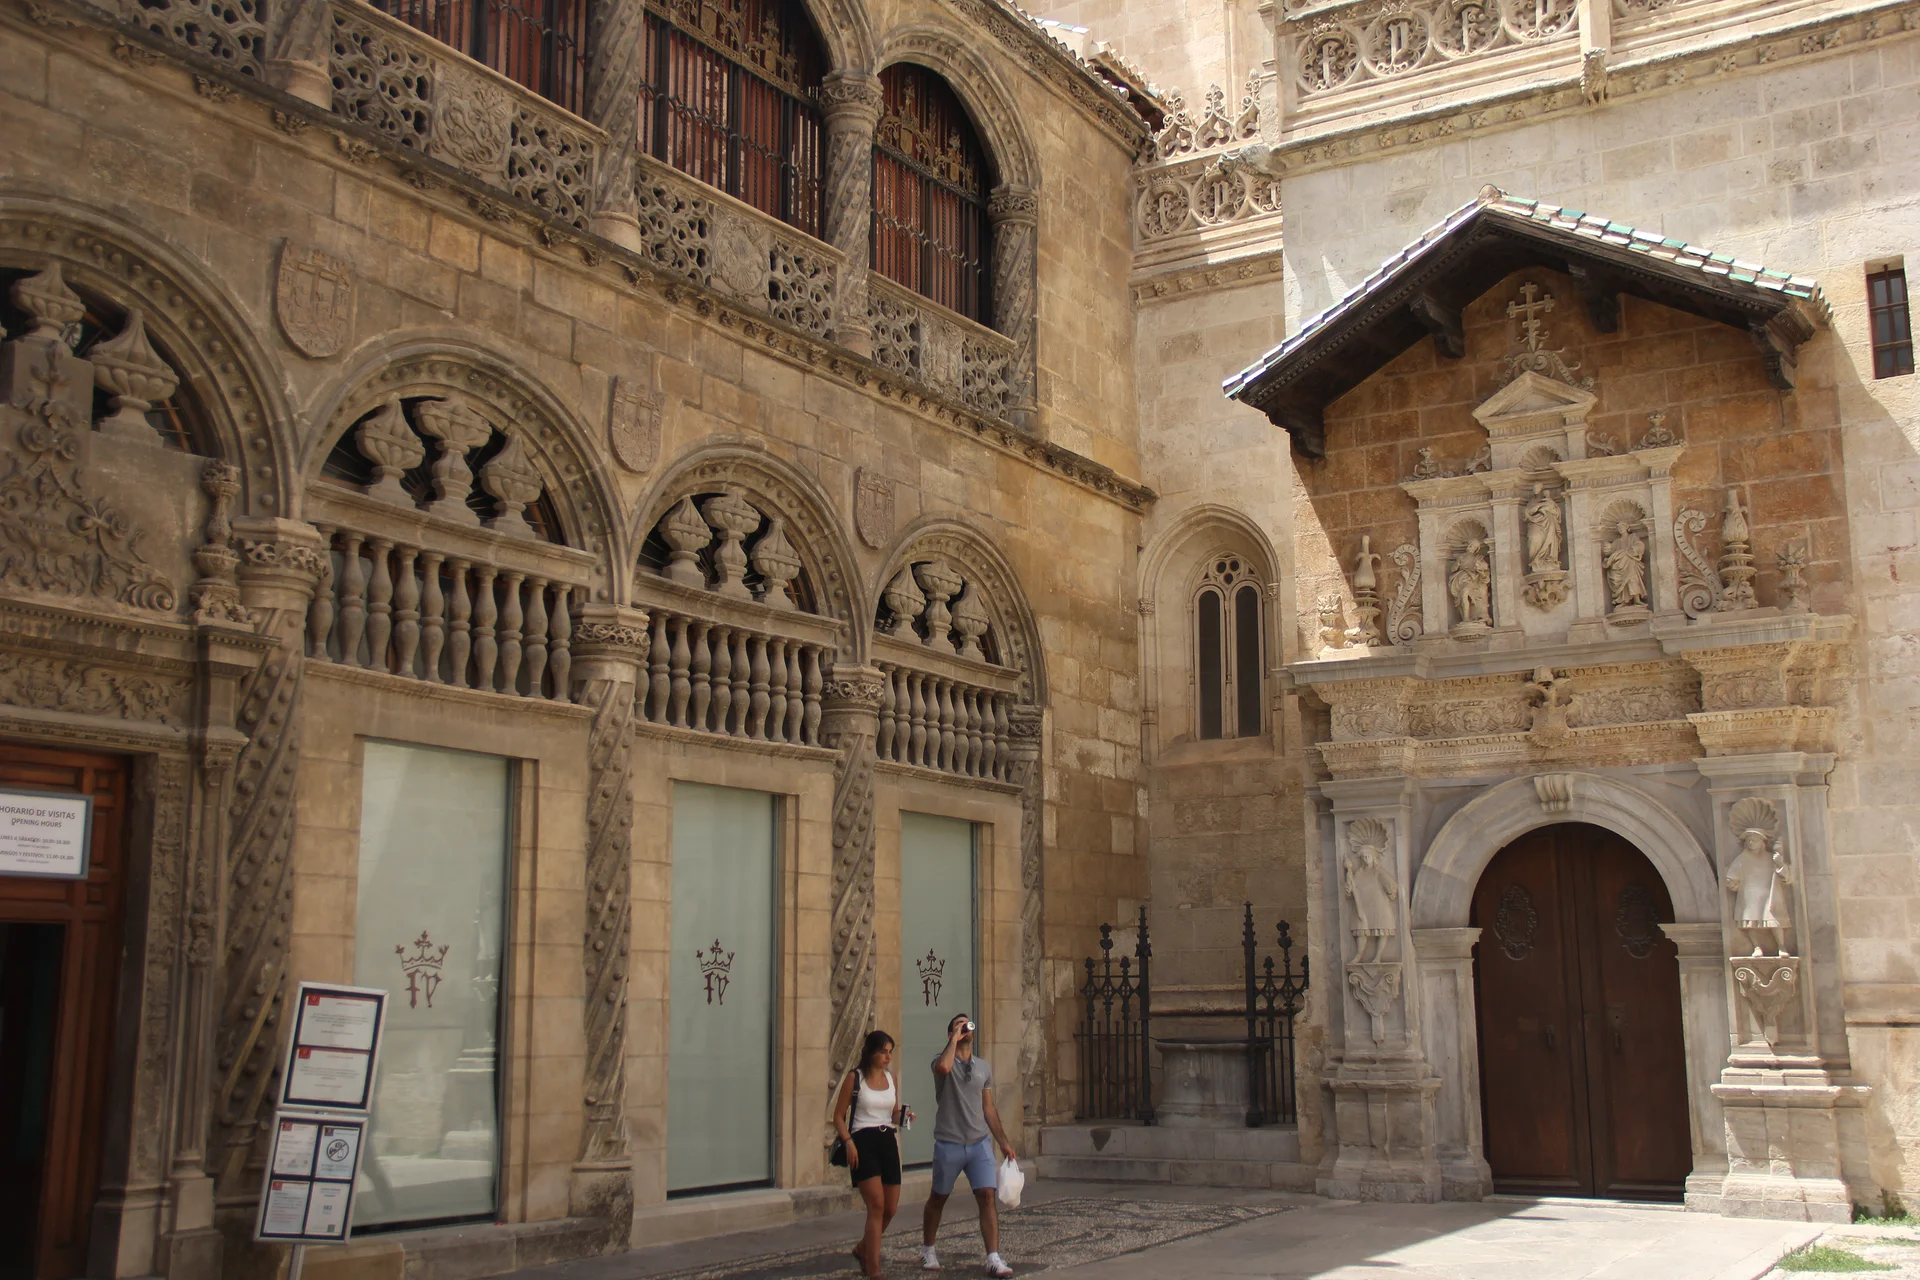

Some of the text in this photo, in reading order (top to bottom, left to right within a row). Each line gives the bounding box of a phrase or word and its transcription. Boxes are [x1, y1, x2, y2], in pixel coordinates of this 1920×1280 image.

[0, 805, 76, 820] HORARIO DE VISITAS
[11, 817, 39, 827] OPENING
